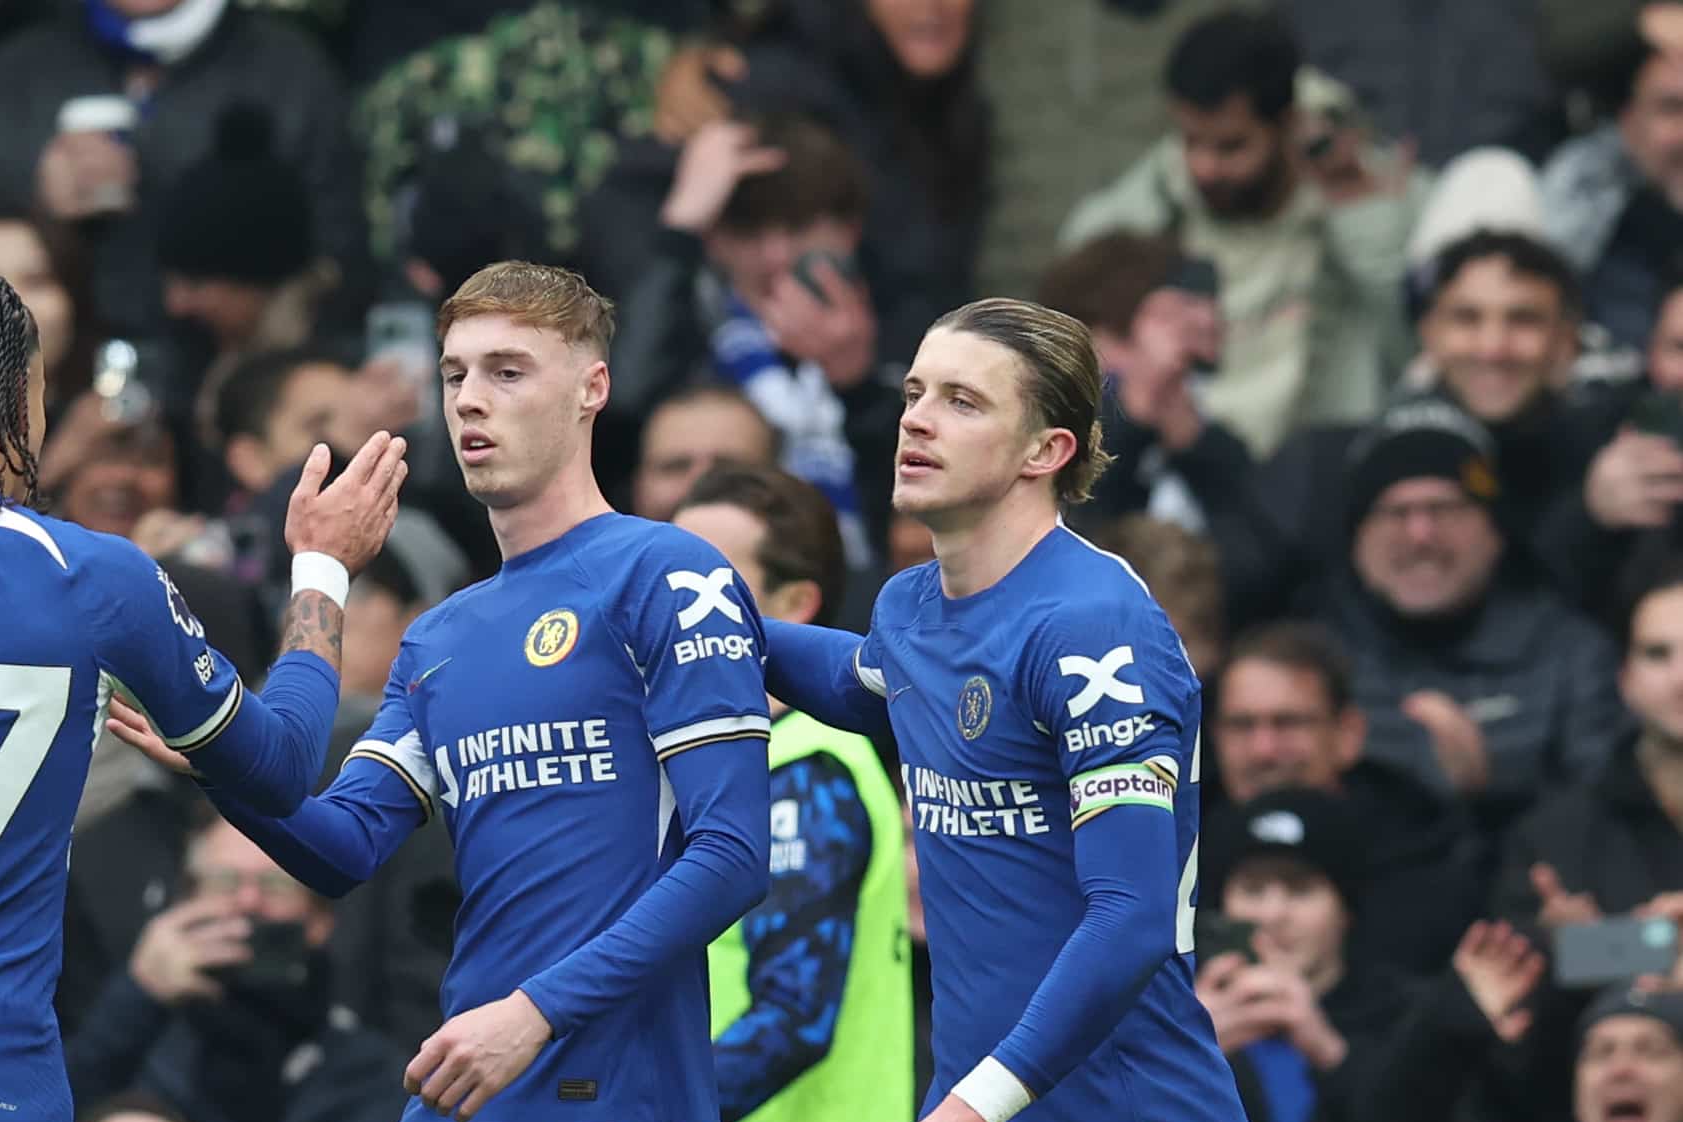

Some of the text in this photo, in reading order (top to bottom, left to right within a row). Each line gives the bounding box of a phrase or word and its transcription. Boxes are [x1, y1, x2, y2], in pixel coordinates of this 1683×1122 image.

[457, 719, 612, 768] INFINITE
[465, 751, 617, 801] ATHLETE
[915, 767, 1039, 808] INFINITE
